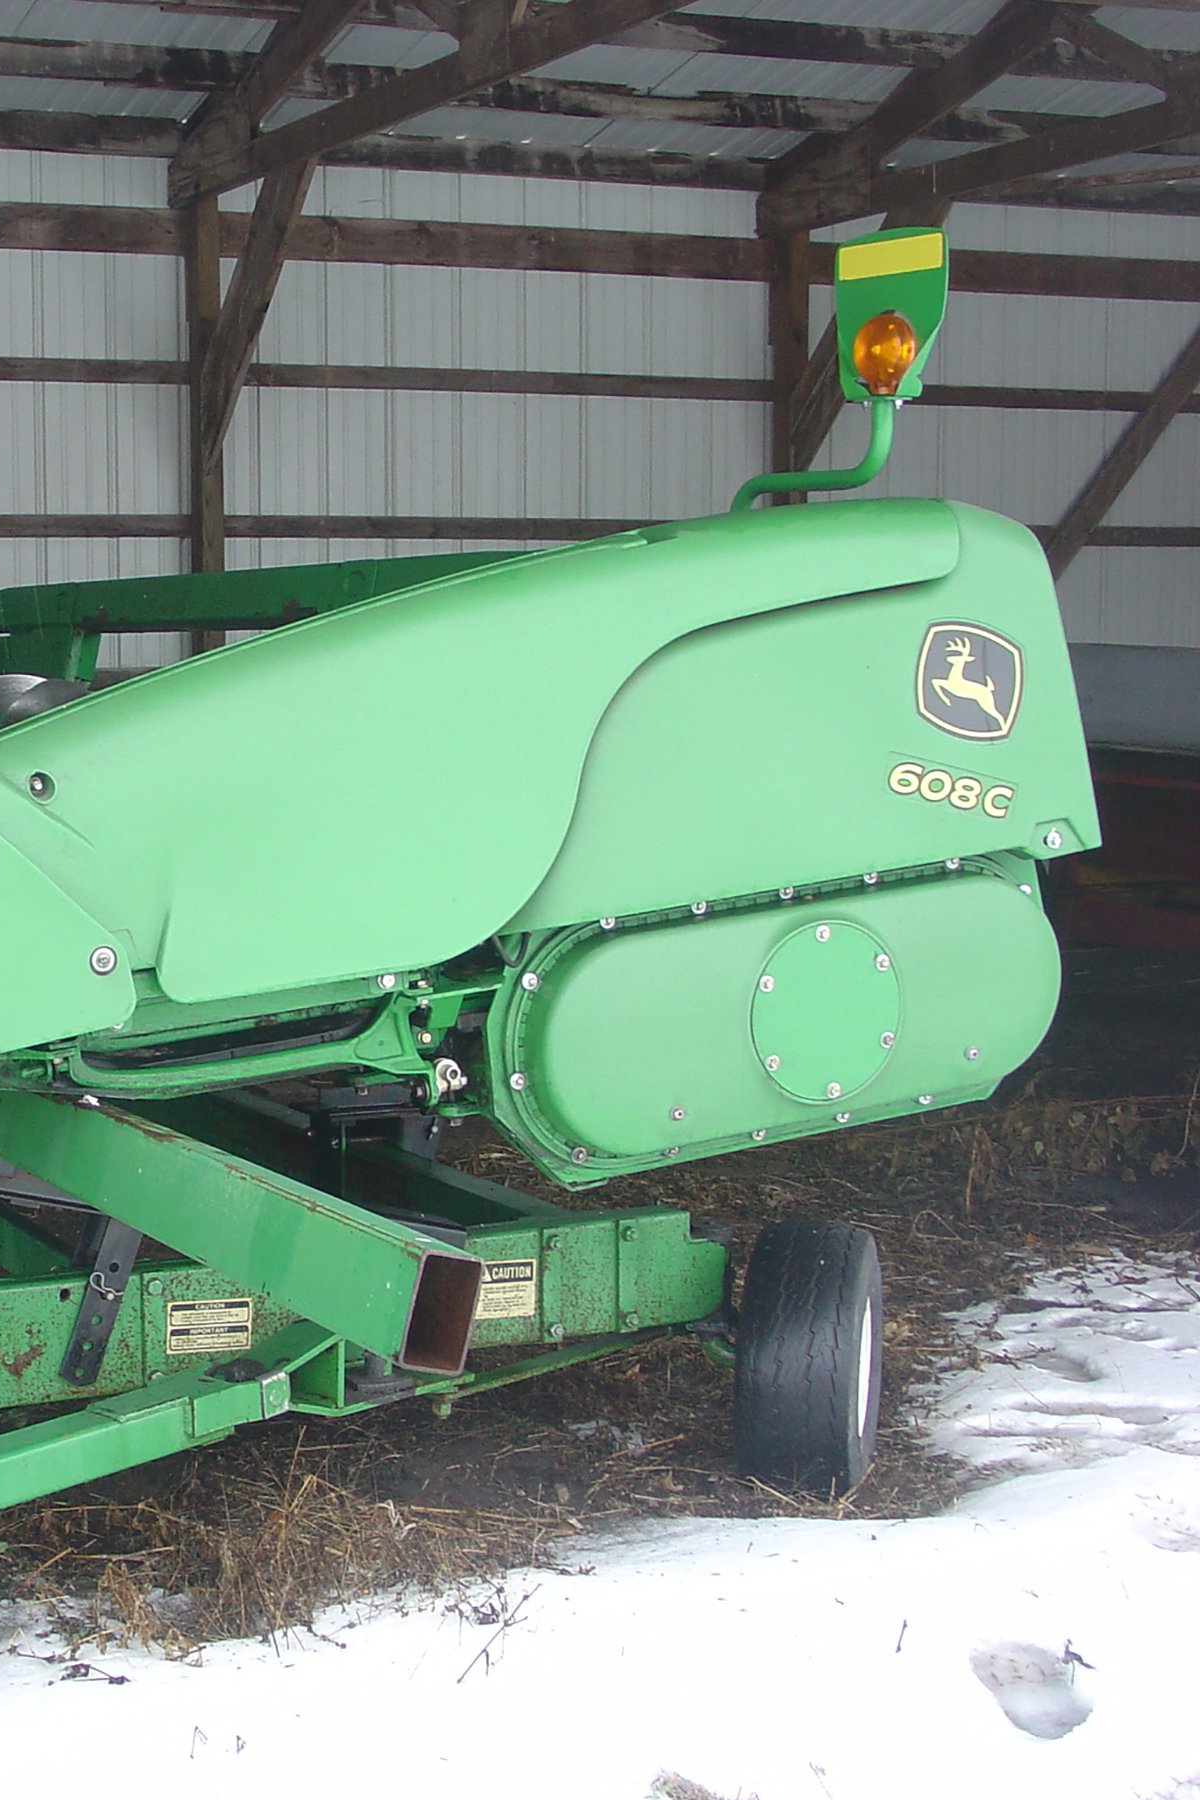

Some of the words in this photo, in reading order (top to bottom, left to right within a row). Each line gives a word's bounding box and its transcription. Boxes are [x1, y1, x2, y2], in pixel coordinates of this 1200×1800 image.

[887, 761, 1016, 819] 608C
[492, 1266, 531, 1280] CAUTION
[189, 1327, 228, 1335] IMPORTANT
